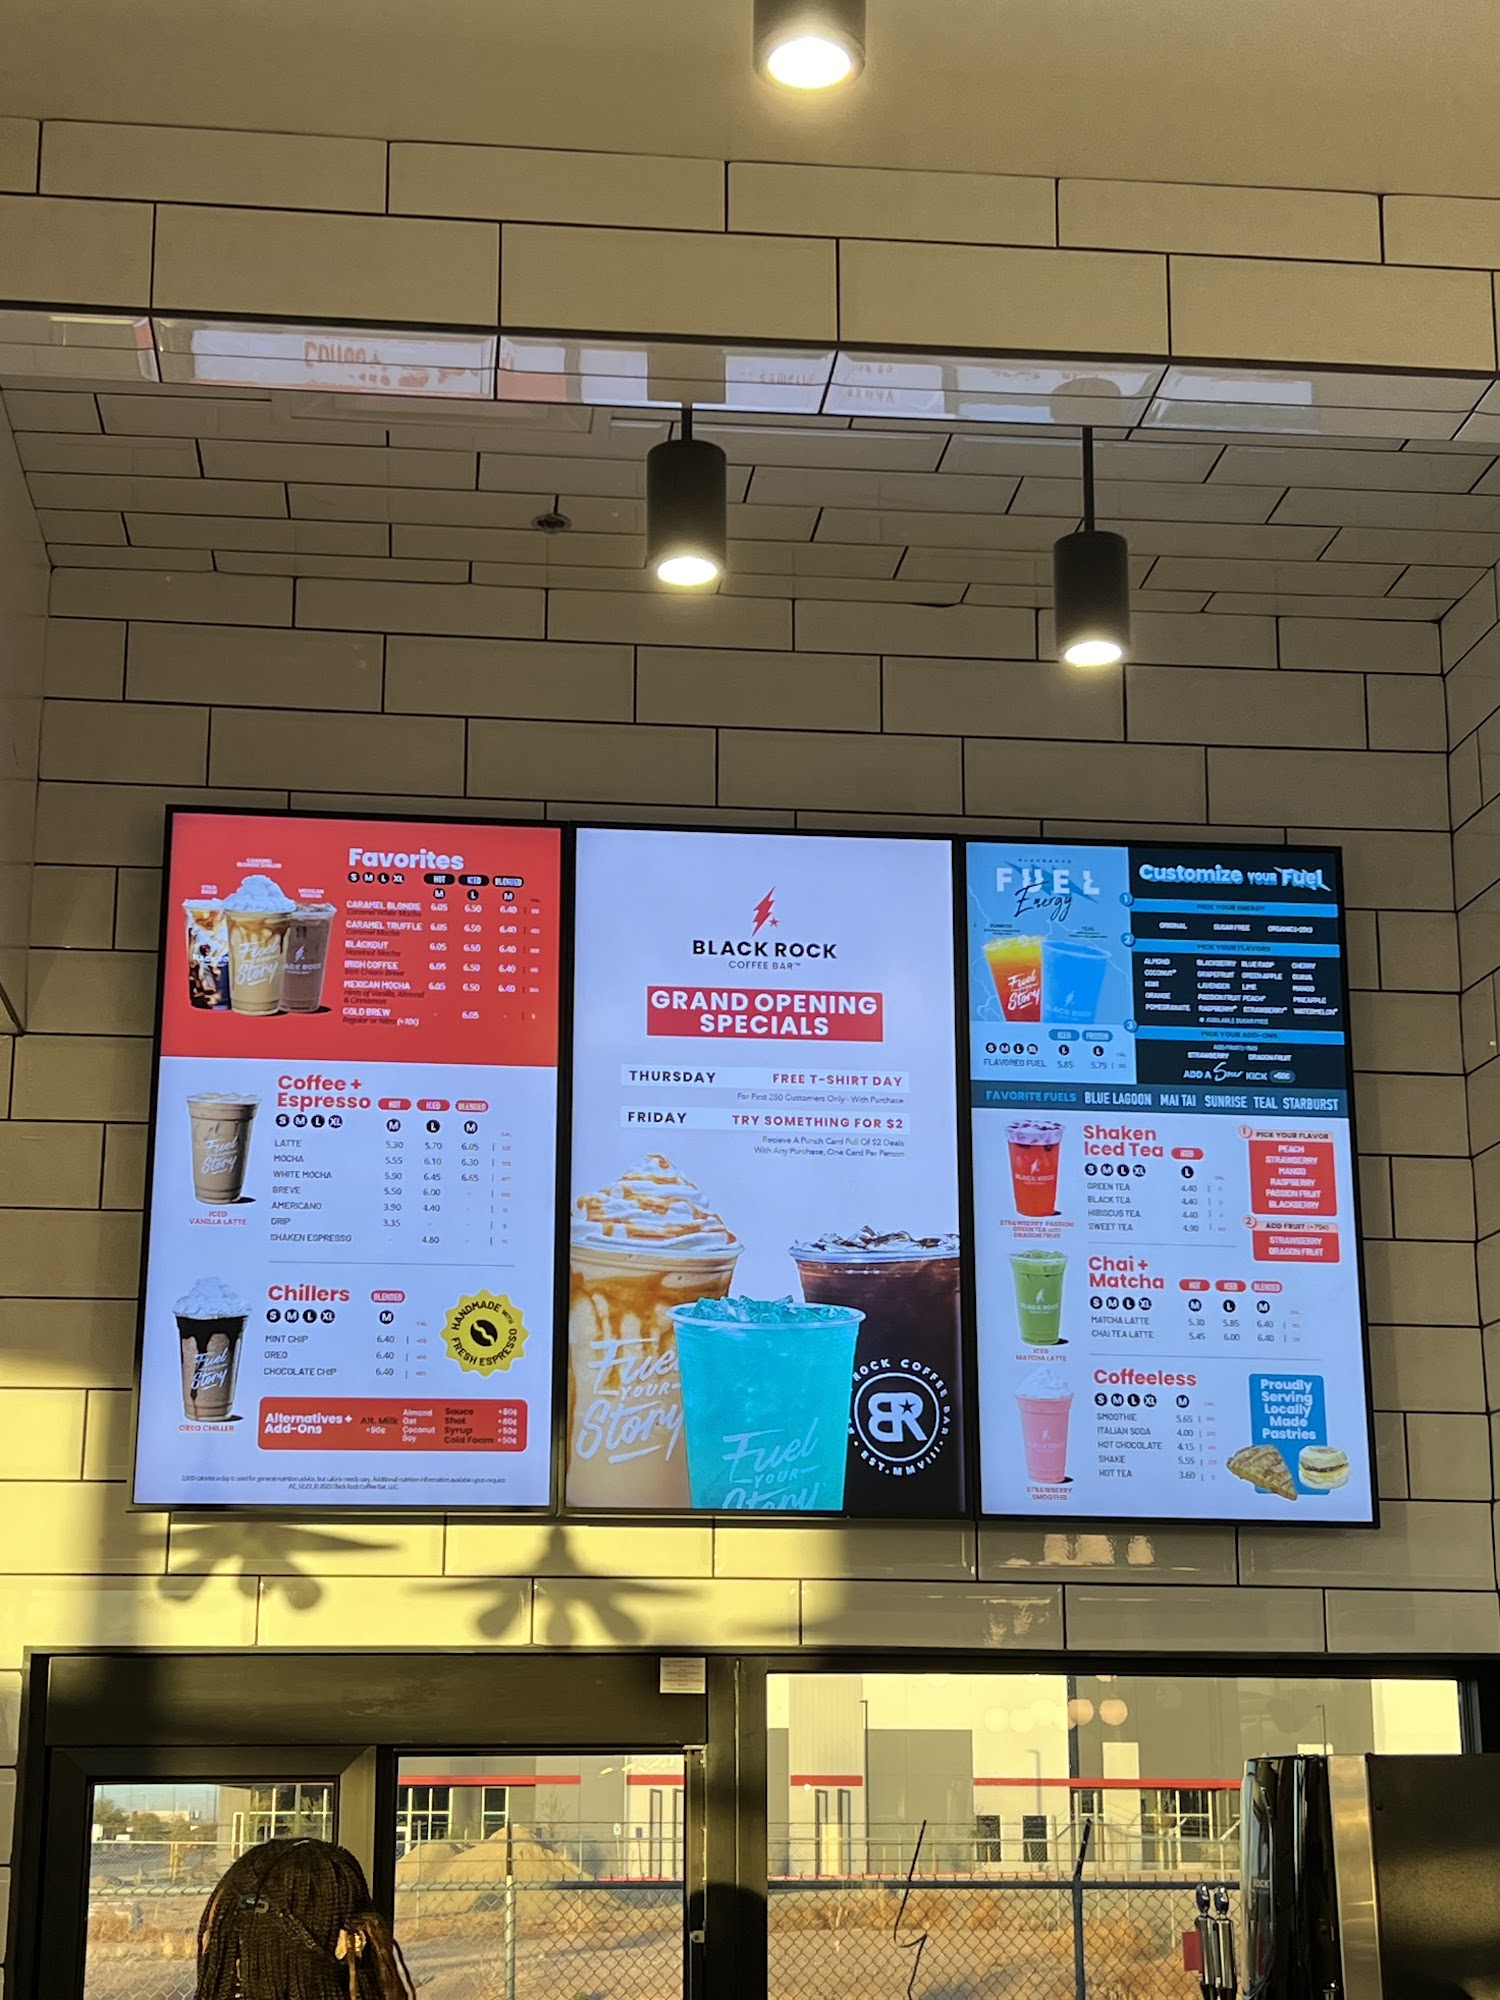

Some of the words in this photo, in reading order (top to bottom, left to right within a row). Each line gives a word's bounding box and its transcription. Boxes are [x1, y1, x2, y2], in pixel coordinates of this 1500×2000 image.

[349, 848, 464, 870] Favorites
[996, 867, 1100, 895] FUEL
[1139, 864, 1244, 885] Customize
[1247, 871, 1277, 885] YOUR
[1280, 867, 1324, 889] Fuel
[1014, 880, 1073, 922] Energy
[346, 900, 385, 910] CARAMEL
[387, 901, 421, 911] BLONDIE
[431, 903, 448, 912] 6.05
[464, 904, 482, 913] 6.50
[346, 920, 384, 930] CARAMEL
[387, 921, 422, 931] TRUFFLE
[345, 940, 389, 950] BLACKOUT
[693, 939, 768, 957] BLACK
[774, 942, 837, 959] ROCK
[367, 961, 398, 970] COFFEE
[728, 960, 769, 970] COFFEE
[343, 980, 380, 989] MEXICAN
[381, 981, 411, 990] MOCHA
[651, 990, 749, 1012] GRAND
[754, 992, 878, 1015] OPENING
[343, 1007, 365, 1016] COLD
[366, 1008, 391, 1017] BREW
[699, 1013, 829, 1036] SPECIALS
[983, 1058, 1024, 1067] FLAVORED
[1026, 1059, 1047, 1068] FUEL
[629, 1070, 716, 1083] THURSDAY
[772, 1072, 805, 1084] FREE
[809, 1074, 869, 1086] T-SHIRT
[872, 1076, 902, 1087] DAY
[1183, 1070, 1203, 1078] ADD
[1245, 1072, 1268, 1080] KICK
[278, 1074, 346, 1091] Coffee
[277, 1092, 372, 1112] Espresso
[737, 1092, 750, 1100] For
[751, 1092, 767, 1101] First
[785, 1093, 826, 1102] Customers
[827, 1095, 846, 1104] Only
[850, 1096, 869, 1104] With
[870, 1096, 904, 1104] Purchase
[985, 1090, 1043, 1101] FAVORITE
[1043, 1091, 1077, 1102] FUELS
[1084, 1091, 1110, 1105] BLUE
[1112, 1092, 1152, 1106] LAGOON
[1160, 1093, 1179, 1106] MAI
[1181, 1094, 1197, 1107] TAI
[1204, 1094, 1248, 1108] SUNRISE
[1253, 1095, 1279, 1109] TEAL
[1282, 1096, 1339, 1111] STARBURST
[628, 1111, 687, 1124] FRIDAY
[732, 1114, 760, 1126] TRY
[764, 1116, 850, 1127] SOMETHING
[854, 1118, 882, 1129] FOR
[886, 1118, 904, 1129] $2
[1083, 1125, 1157, 1141] Shaken
[1275, 1131, 1298, 1139] YOUR
[1298, 1132, 1329, 1140] FLAVOR
[274, 1139, 302, 1147] LATTE
[425, 1142, 443, 1150] 5.70
[461, 1143, 479, 1151] 6.05
[825, 1137, 844, 1145] Card
[845, 1149, 864, 1157] Card
[1084, 1141, 1125, 1156] Iced
[1128, 1142, 1164, 1157] Tea
[1277, 1144, 1305, 1153] PEACH
[273, 1154, 304, 1163] MOCHA
[385, 1156, 403, 1165] 5.55
[423, 1157, 442, 1166] 6.10
[461, 1158, 479, 1166] 6.30
[1265, 1155, 1318, 1164] STRAWBERRY
[273, 1170, 302, 1178] WHITE
[302, 1171, 332, 1179] MOCHA
[384, 1172, 403, 1180] 5.90
[423, 1173, 441, 1181] 6.45
[461, 1174, 479, 1182] 6.65
[1278, 1167, 1306, 1175] MANGO
[1086, 1182, 1113, 1191] GREEN
[1115, 1182, 1131, 1191] TEA
[1269, 1177, 1316, 1186] RASPBERRY
[272, 1186, 301, 1194] BREVE
[383, 1187, 402, 1195] 5.50
[422, 1188, 441, 1196] 6.00
[1265, 1188, 1298, 1197] PASSION
[1299, 1189, 1322, 1198] FRUIT
[1087, 1195, 1114, 1204] BLACK
[1116, 1196, 1131, 1204] TEA
[1268, 1200, 1320, 1209] BLACKBERRY
[271, 1202, 322, 1210] AMERICANO
[383, 1203, 402, 1212] 3.90
[1088, 1209, 1124, 1217] HIBISCUS
[1125, 1209, 1141, 1218] TEA
[270, 1217, 291, 1225] DRIP
[1088, 1222, 1116, 1231] SWEET
[1117, 1223, 1133, 1231] TEA
[270, 1233, 305, 1241] SHAKEN
[307, 1233, 352, 1242] ESPRESSO
[1268, 1236, 1323, 1245] STRAWBERRY
[1088, 1256, 1134, 1272] Chai
[1089, 1273, 1165, 1289] Matcha
[268, 1283, 351, 1302] Chillers
[451, 1300, 502, 1331] HANDMADE
[1091, 1316, 1124, 1325] MATCHA
[1124, 1316, 1150, 1325] LATTE
[265, 1335, 286, 1343] MINT
[287, 1335, 309, 1343] CHIP
[376, 1335, 395, 1343] 6.40
[1091, 1330, 1111, 1338] CHAI
[1128, 1330, 1154, 1339] LATTE
[451, 1336, 478, 1365] FRESH
[479, 1328, 518, 1367] ESPRESSO
[264, 1350, 288, 1359] OREO
[376, 1351, 394, 1360] 6.40
[263, 1367, 315, 1376] CHOCOLATE
[316, 1367, 337, 1376] CHIP
[375, 1367, 394, 1376] 6.40
[900, 1358, 949, 1398] COFFEE
[1093, 1368, 1197, 1386] Coffeeless
[1260, 1378, 1313, 1394] Proudly
[1261, 1391, 1313, 1406] Serving
[444, 1407, 475, 1416] Sauce
[1264, 1403, 1311, 1418] Locally
[265, 1412, 343, 1424] Alternatives
[444, 1417, 466, 1425] Shot
[1096, 1413, 1137, 1421] SMOOTHIE
[1269, 1415, 1309, 1427] Made
[264, 1423, 323, 1434] Add-Ons
[402, 1426, 436, 1434] Coconut
[444, 1426, 473, 1436] Syrup
[576, 1398, 684, 1462] Story
[1097, 1426, 1128, 1435] ITALIAN
[1129, 1427, 1151, 1435] SODA
[1176, 1429, 1194, 1437] 4.00
[1262, 1427, 1317, 1440] Pastries
[444, 1436, 466, 1444] Cold
[722, 1417, 820, 1484] Fuel
[1097, 1441, 1113, 1449] HOT
[1115, 1441, 1163, 1450] CHOCOLATE
[1177, 1443, 1195, 1451] 4.15
[1097, 1455, 1126, 1464] SHAKE
[1098, 1469, 1115, 1477] HOT
[1116, 1469, 1133, 1477] TEA
